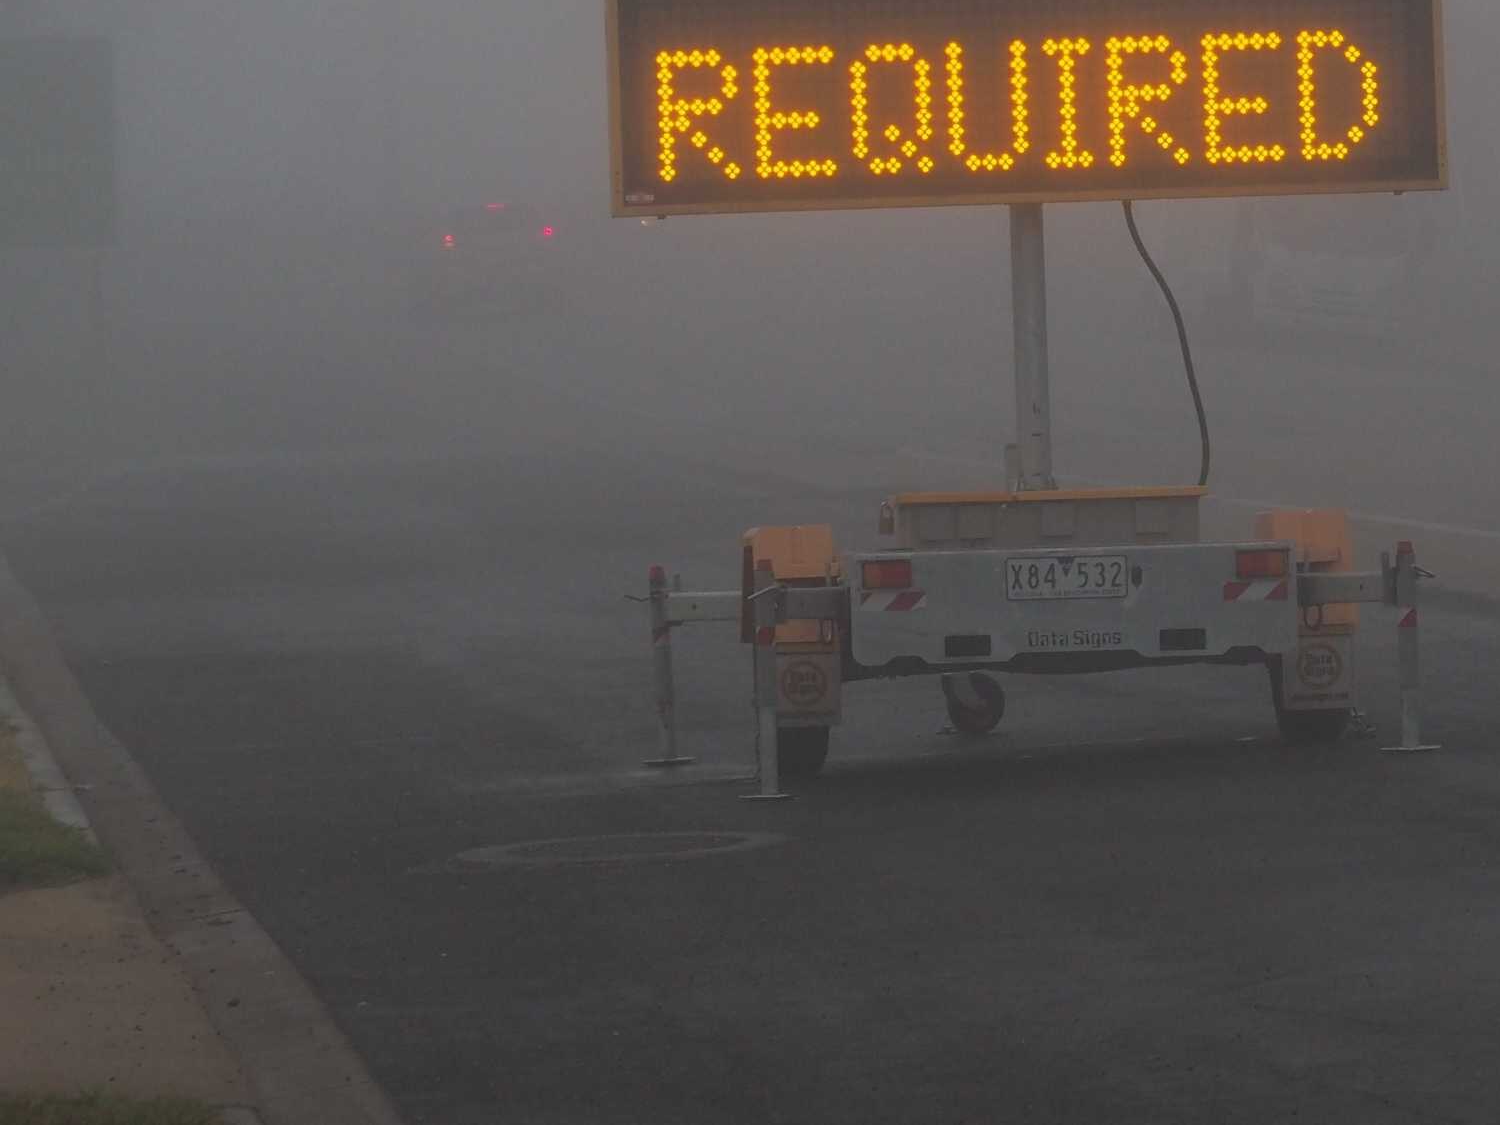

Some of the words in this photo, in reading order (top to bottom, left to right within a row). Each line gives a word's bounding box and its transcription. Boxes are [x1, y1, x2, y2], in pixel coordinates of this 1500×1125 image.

[654, 28, 1380, 182] REQUIRED
[1010, 562, 1057, 591] X84
[1076, 561, 1123, 589] 532
[1027, 629, 1069, 648] Data
[1072, 628, 1122, 649] Signs
